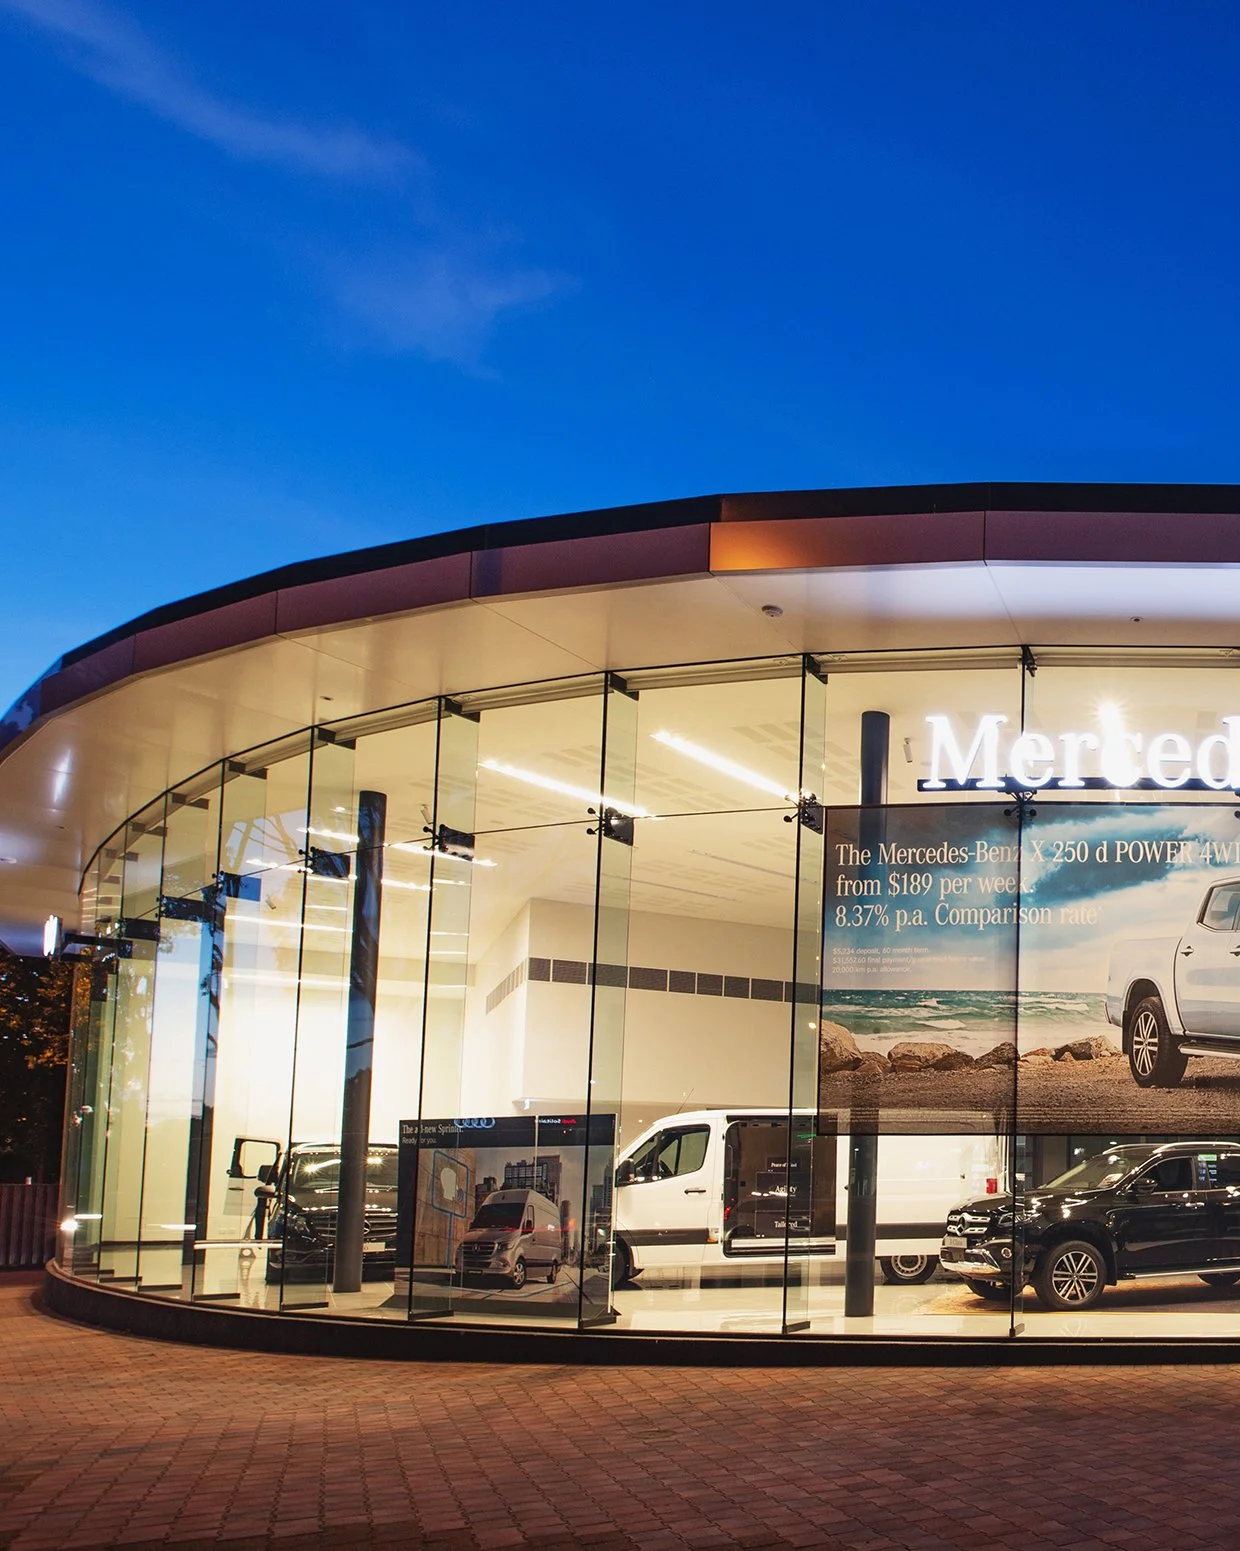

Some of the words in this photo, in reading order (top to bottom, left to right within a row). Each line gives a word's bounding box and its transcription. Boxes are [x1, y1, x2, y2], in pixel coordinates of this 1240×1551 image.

[836, 843, 871, 866] The
[877, 840, 1023, 865] Mercedes-Benz
[1030, 839, 1048, 862] X
[1053, 840, 1089, 864] 250
[1095, 840, 1108, 863] d
[1114, 840, 1193, 864] POWER
[836, 874, 882, 897] from
[888, 870, 933, 898] $189
[939, 875, 972, 900] per
[977, 873, 1035, 894] week.
[835, 904, 889, 927] 8.37%
[895, 907, 928, 931] p.a.
[935, 902, 1052, 930] Comparison
[402, 1124, 414, 1134] The
[414, 1123, 437, 1134] al-new
[401, 1136, 418, 1145] Ready
[774, 1184, 798, 1194] Agilty
